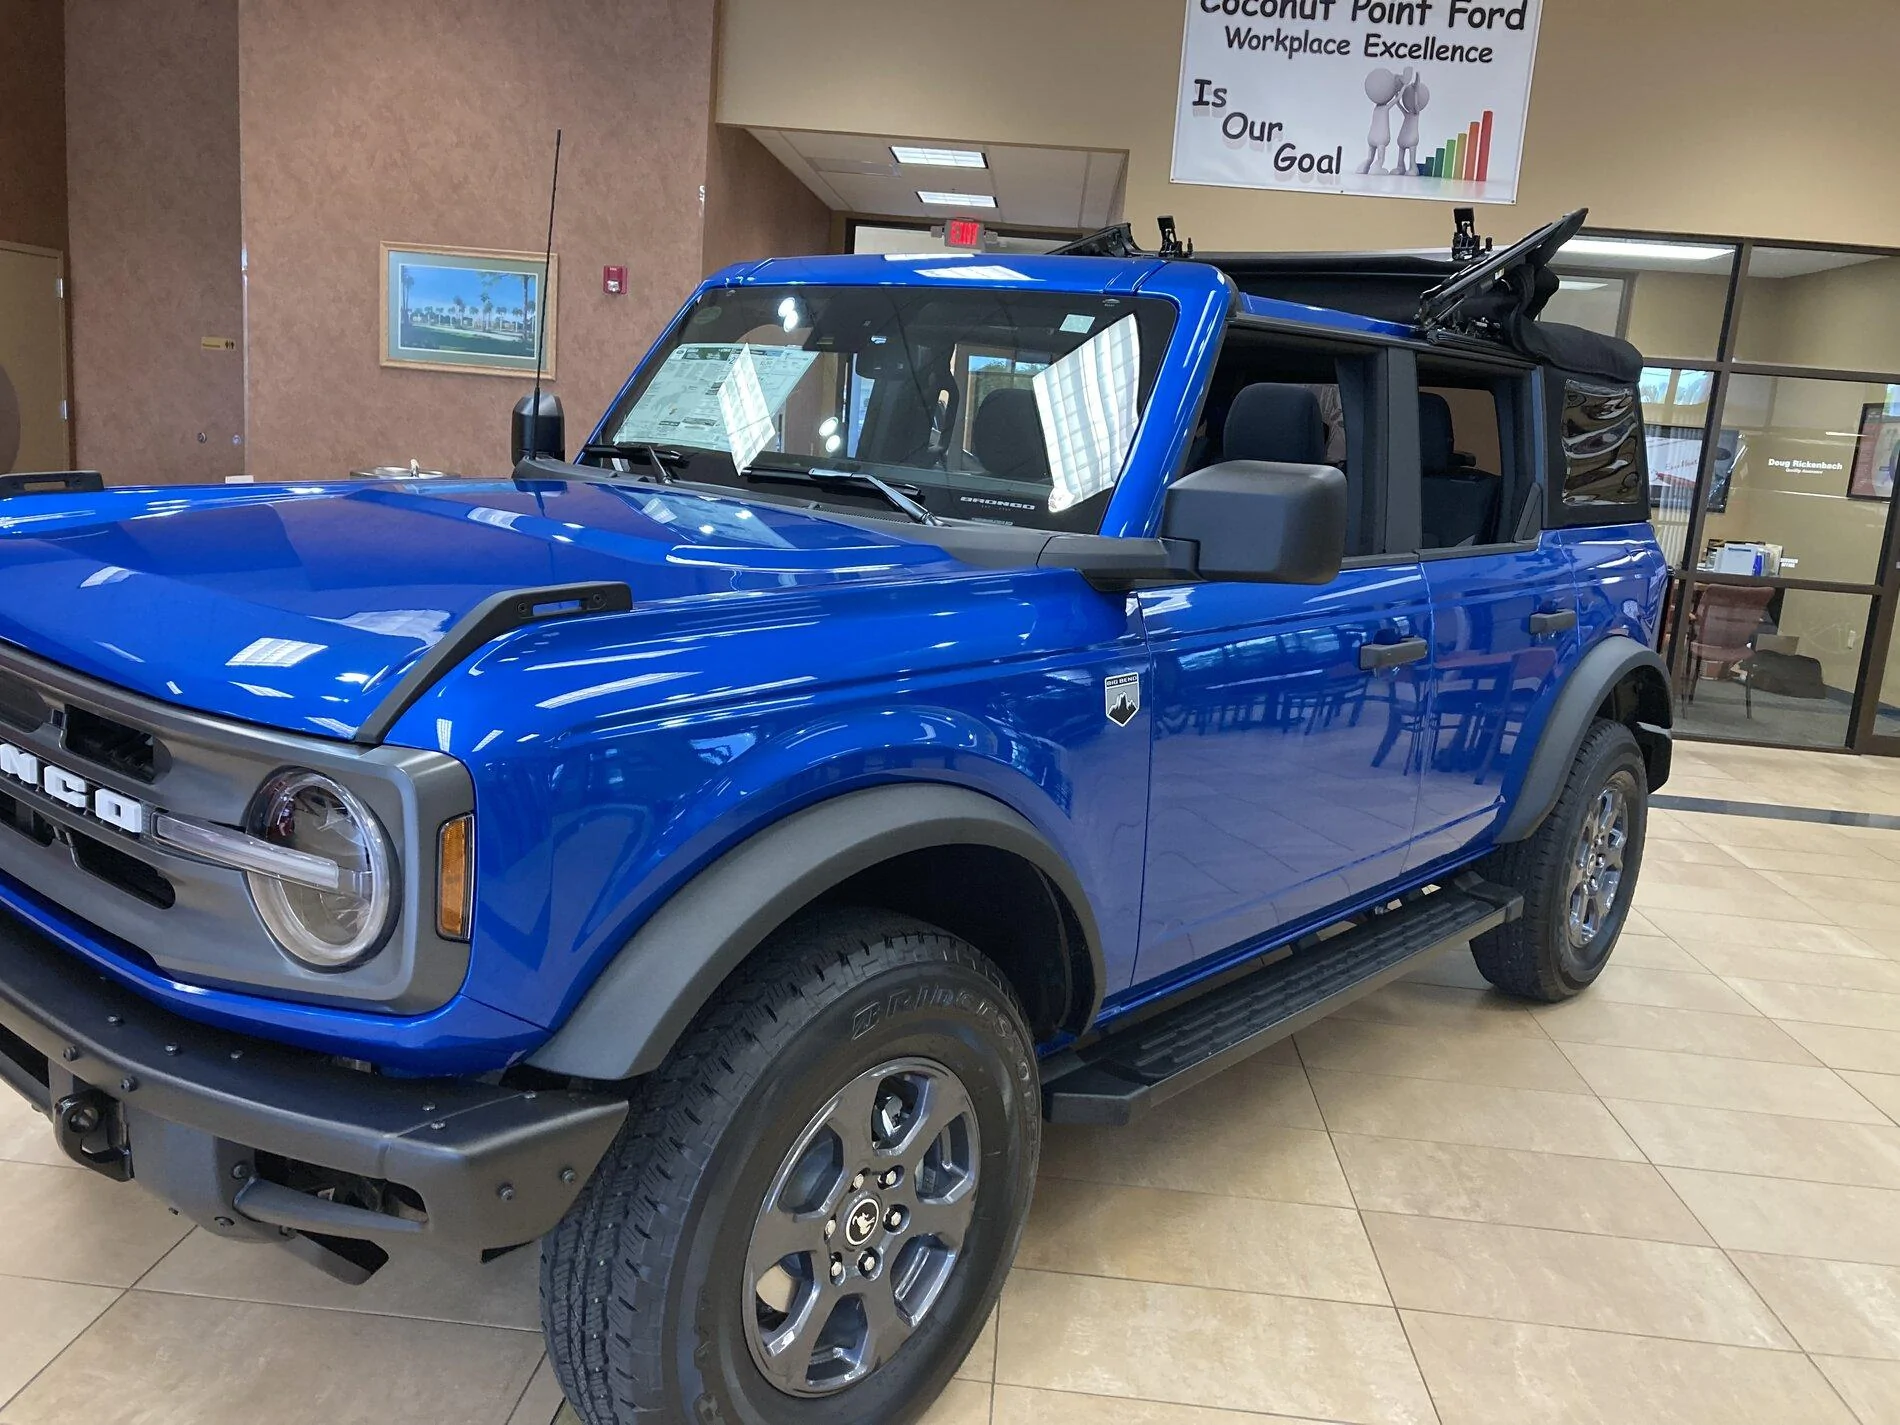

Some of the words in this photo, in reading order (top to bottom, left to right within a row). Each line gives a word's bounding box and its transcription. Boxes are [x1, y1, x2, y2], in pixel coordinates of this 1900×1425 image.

[1352, 0, 1433, 26] Point
[1448, 0, 1528, 31] Ford
[1225, 25, 1351, 60] Workplace
[1364, 33, 1493, 63] Excellence
[1192, 78, 1228, 108] Is
[1221, 111, 1283, 142] Our
[1273, 143, 1343, 175] Goal
[1767, 458, 1790, 468] Doug
[1792, 460, 1843, 470] Rickenbach
[960, 496, 1036, 510] BRONCO
